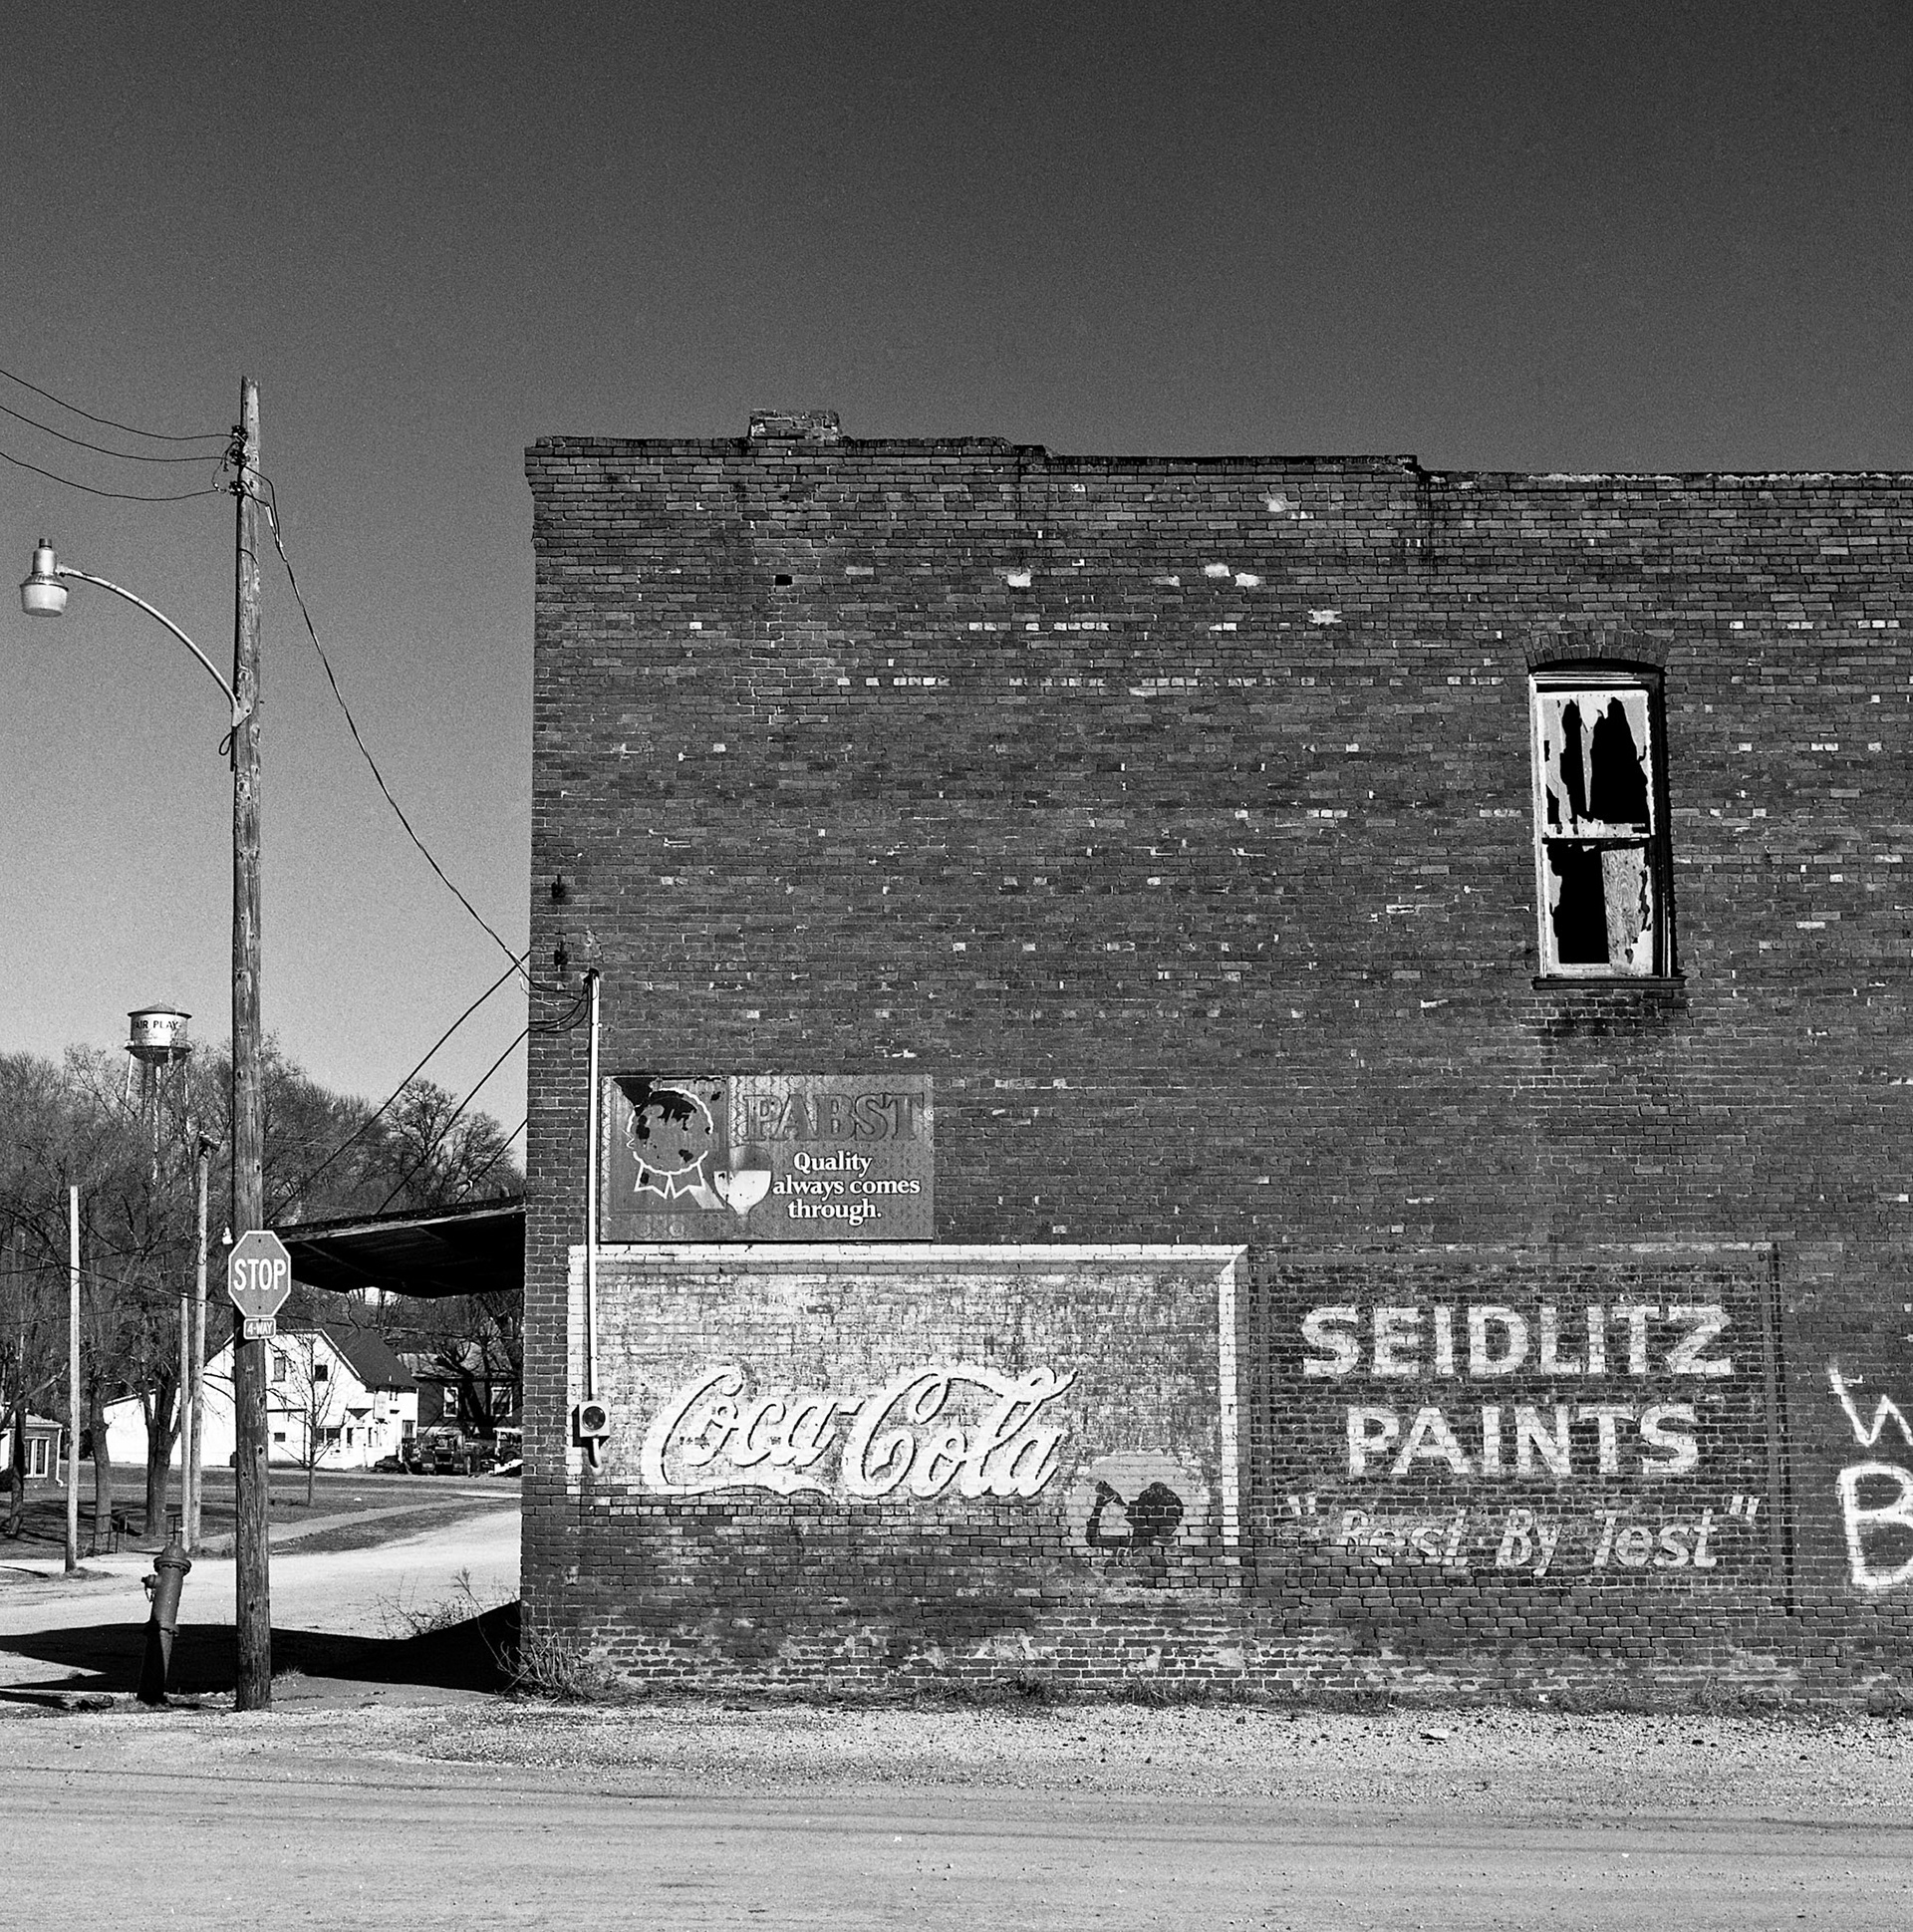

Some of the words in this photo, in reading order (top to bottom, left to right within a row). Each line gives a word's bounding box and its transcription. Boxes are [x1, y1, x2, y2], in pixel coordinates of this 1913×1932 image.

[152, 1020, 178, 1030] PLAY
[742, 1092, 924, 1142] PABST
[793, 1150, 874, 1178] Quality
[772, 1174, 845, 1202] always
[849, 1179, 922, 1195] comes
[787, 1198, 883, 1227] through.
[233, 1258, 286, 1291] STOP
[247, 1321, 273, 1335] 4-WAY
[1300, 1304, 1732, 1376] SEIDLITZ
[1347, 1405, 1700, 1476] PAINTS
[1495, 1509, 1562, 1576] By
